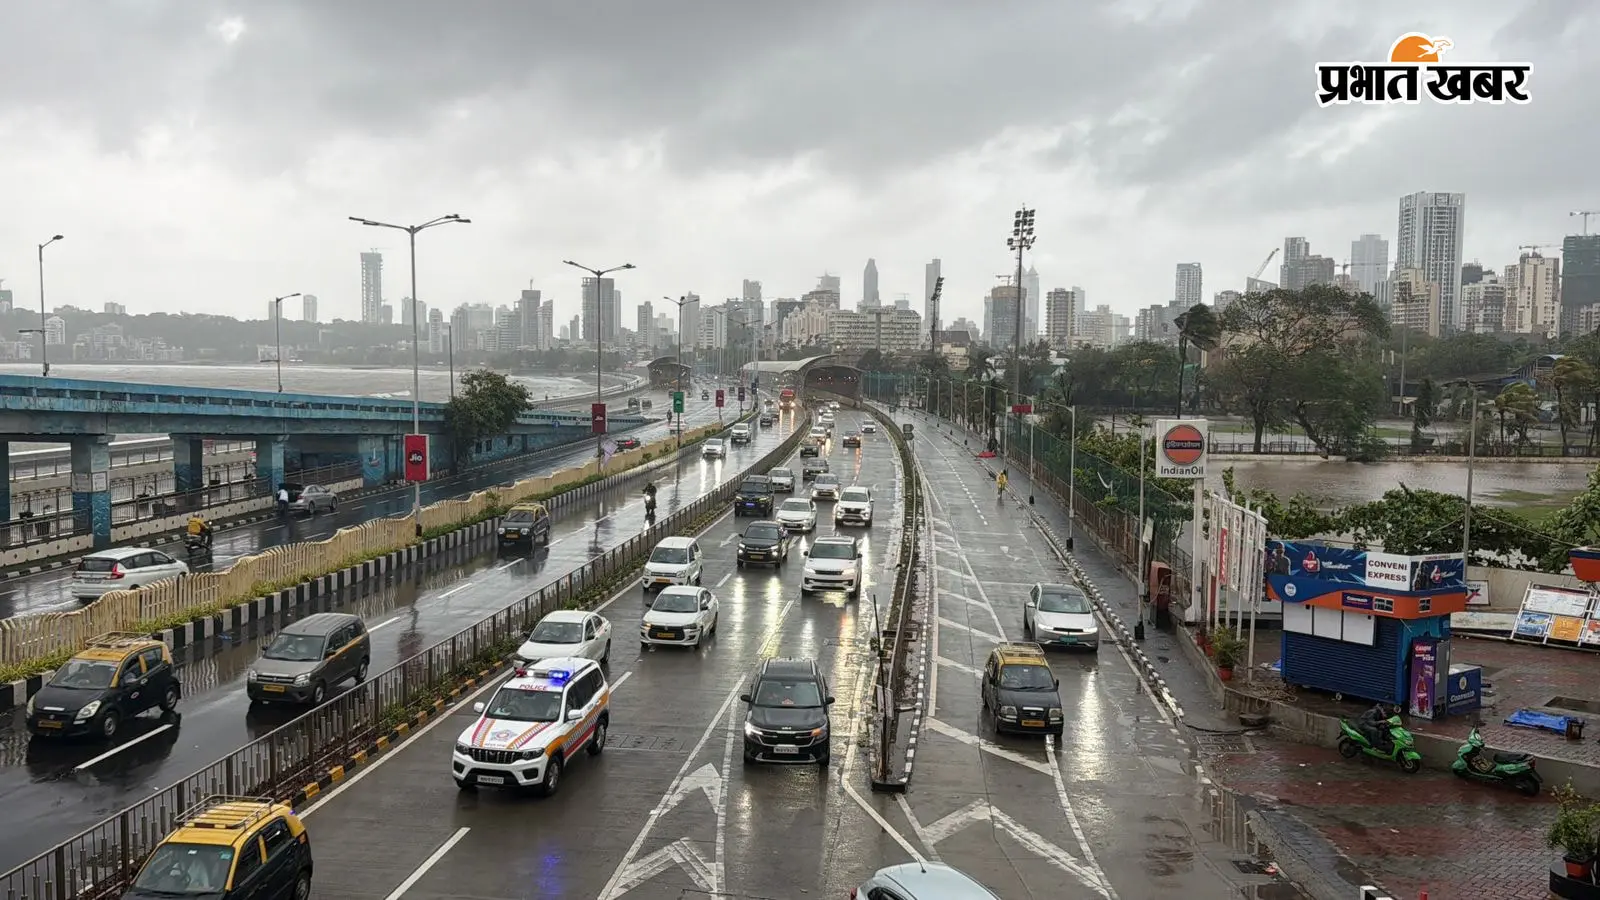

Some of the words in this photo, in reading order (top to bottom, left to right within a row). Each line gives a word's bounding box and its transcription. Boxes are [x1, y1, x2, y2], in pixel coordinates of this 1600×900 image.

[409, 453, 423, 462] Jio
[1160, 465, 1204, 475] IndianOil
[1368, 560, 1408, 571] CONVENI
[1367, 571, 1407, 582] EXPRESS
[519, 683, 548, 691] POLICE
